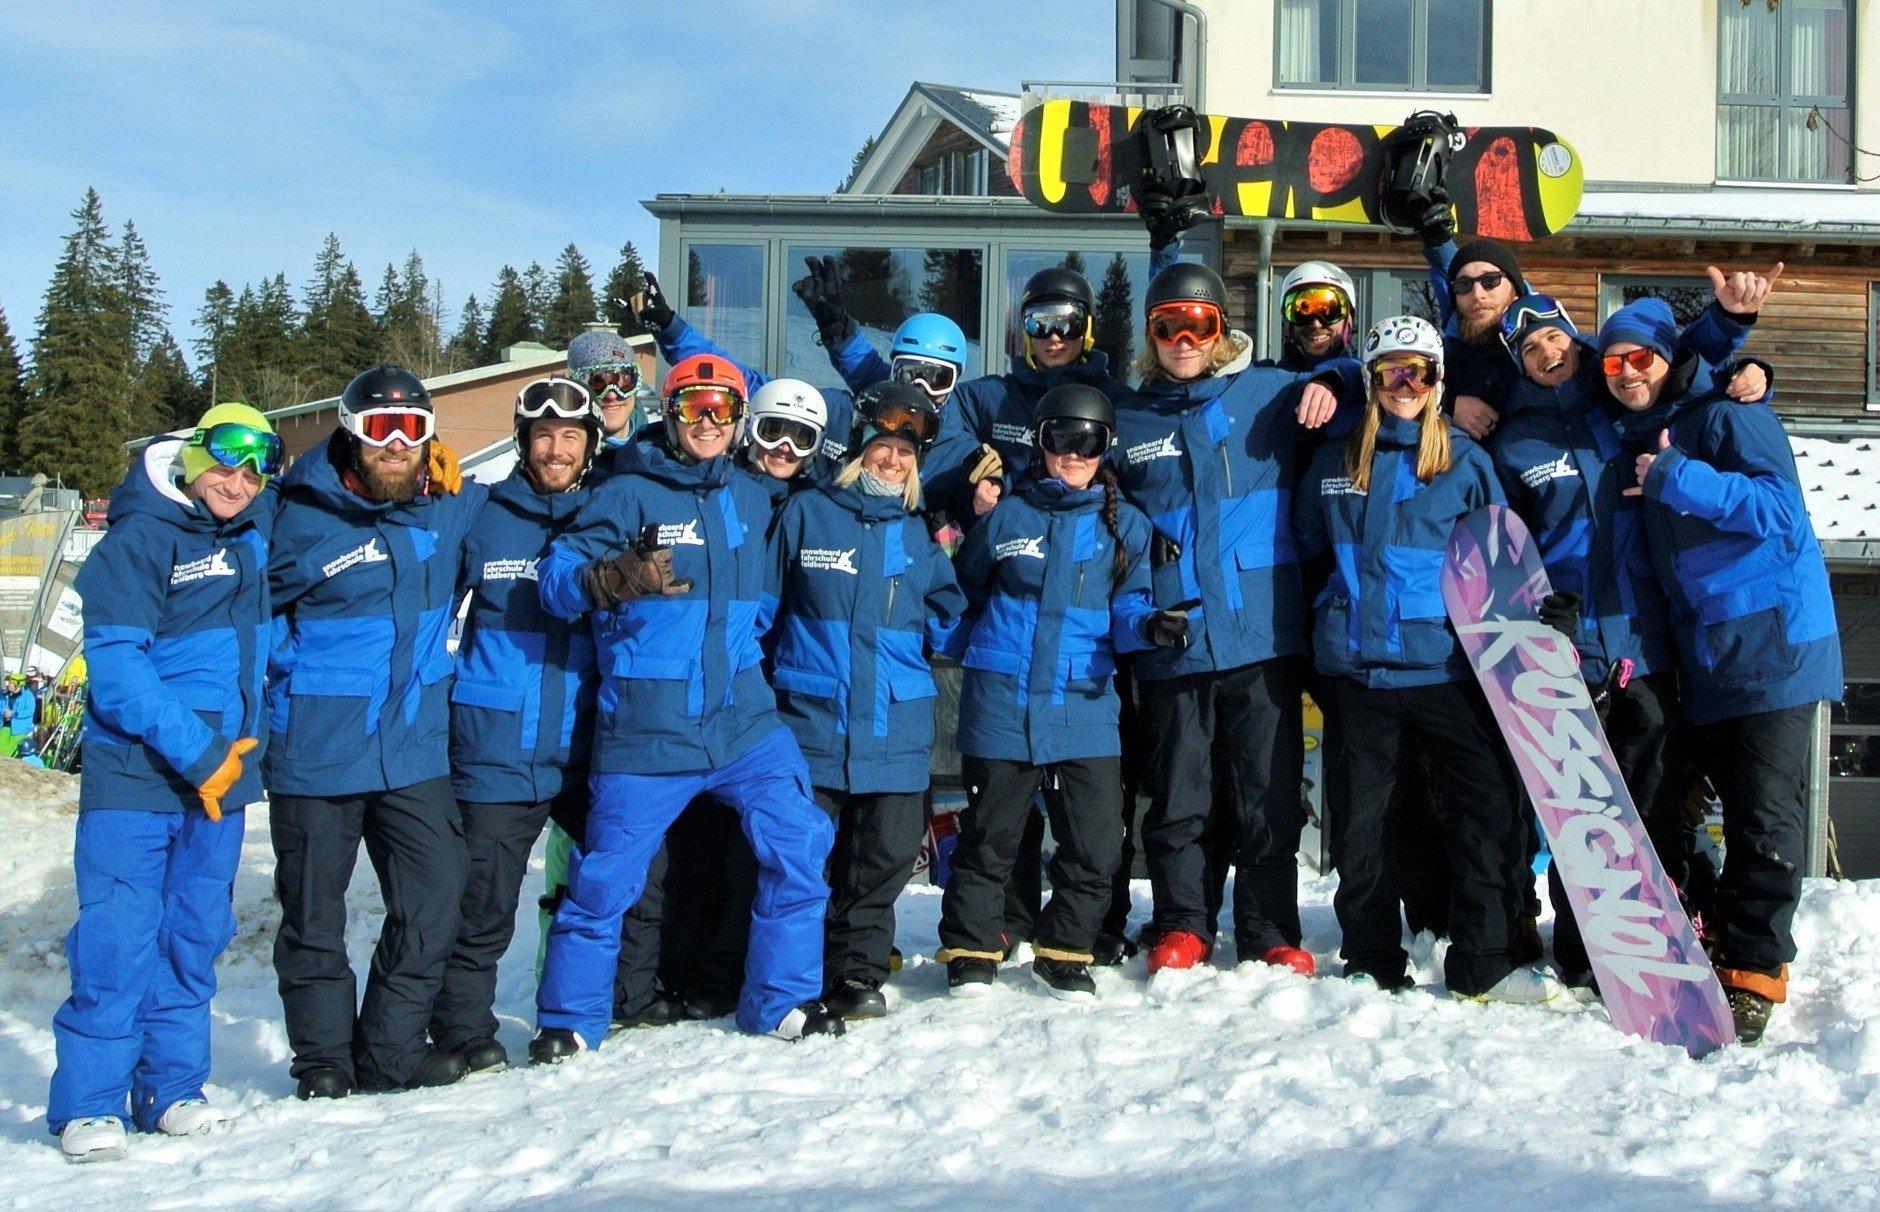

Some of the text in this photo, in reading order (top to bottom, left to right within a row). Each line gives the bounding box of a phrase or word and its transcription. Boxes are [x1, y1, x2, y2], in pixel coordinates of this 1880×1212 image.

[1126, 437, 1163, 454] snowboard
[801, 547, 842, 557] snowboard
[322, 545, 364, 573] snowboard
[801, 554, 838, 563] fahrschule
[483, 565, 524, 574] fahrschule
[801, 560, 830, 570] feldberg
[483, 572, 517, 581] feldberg
